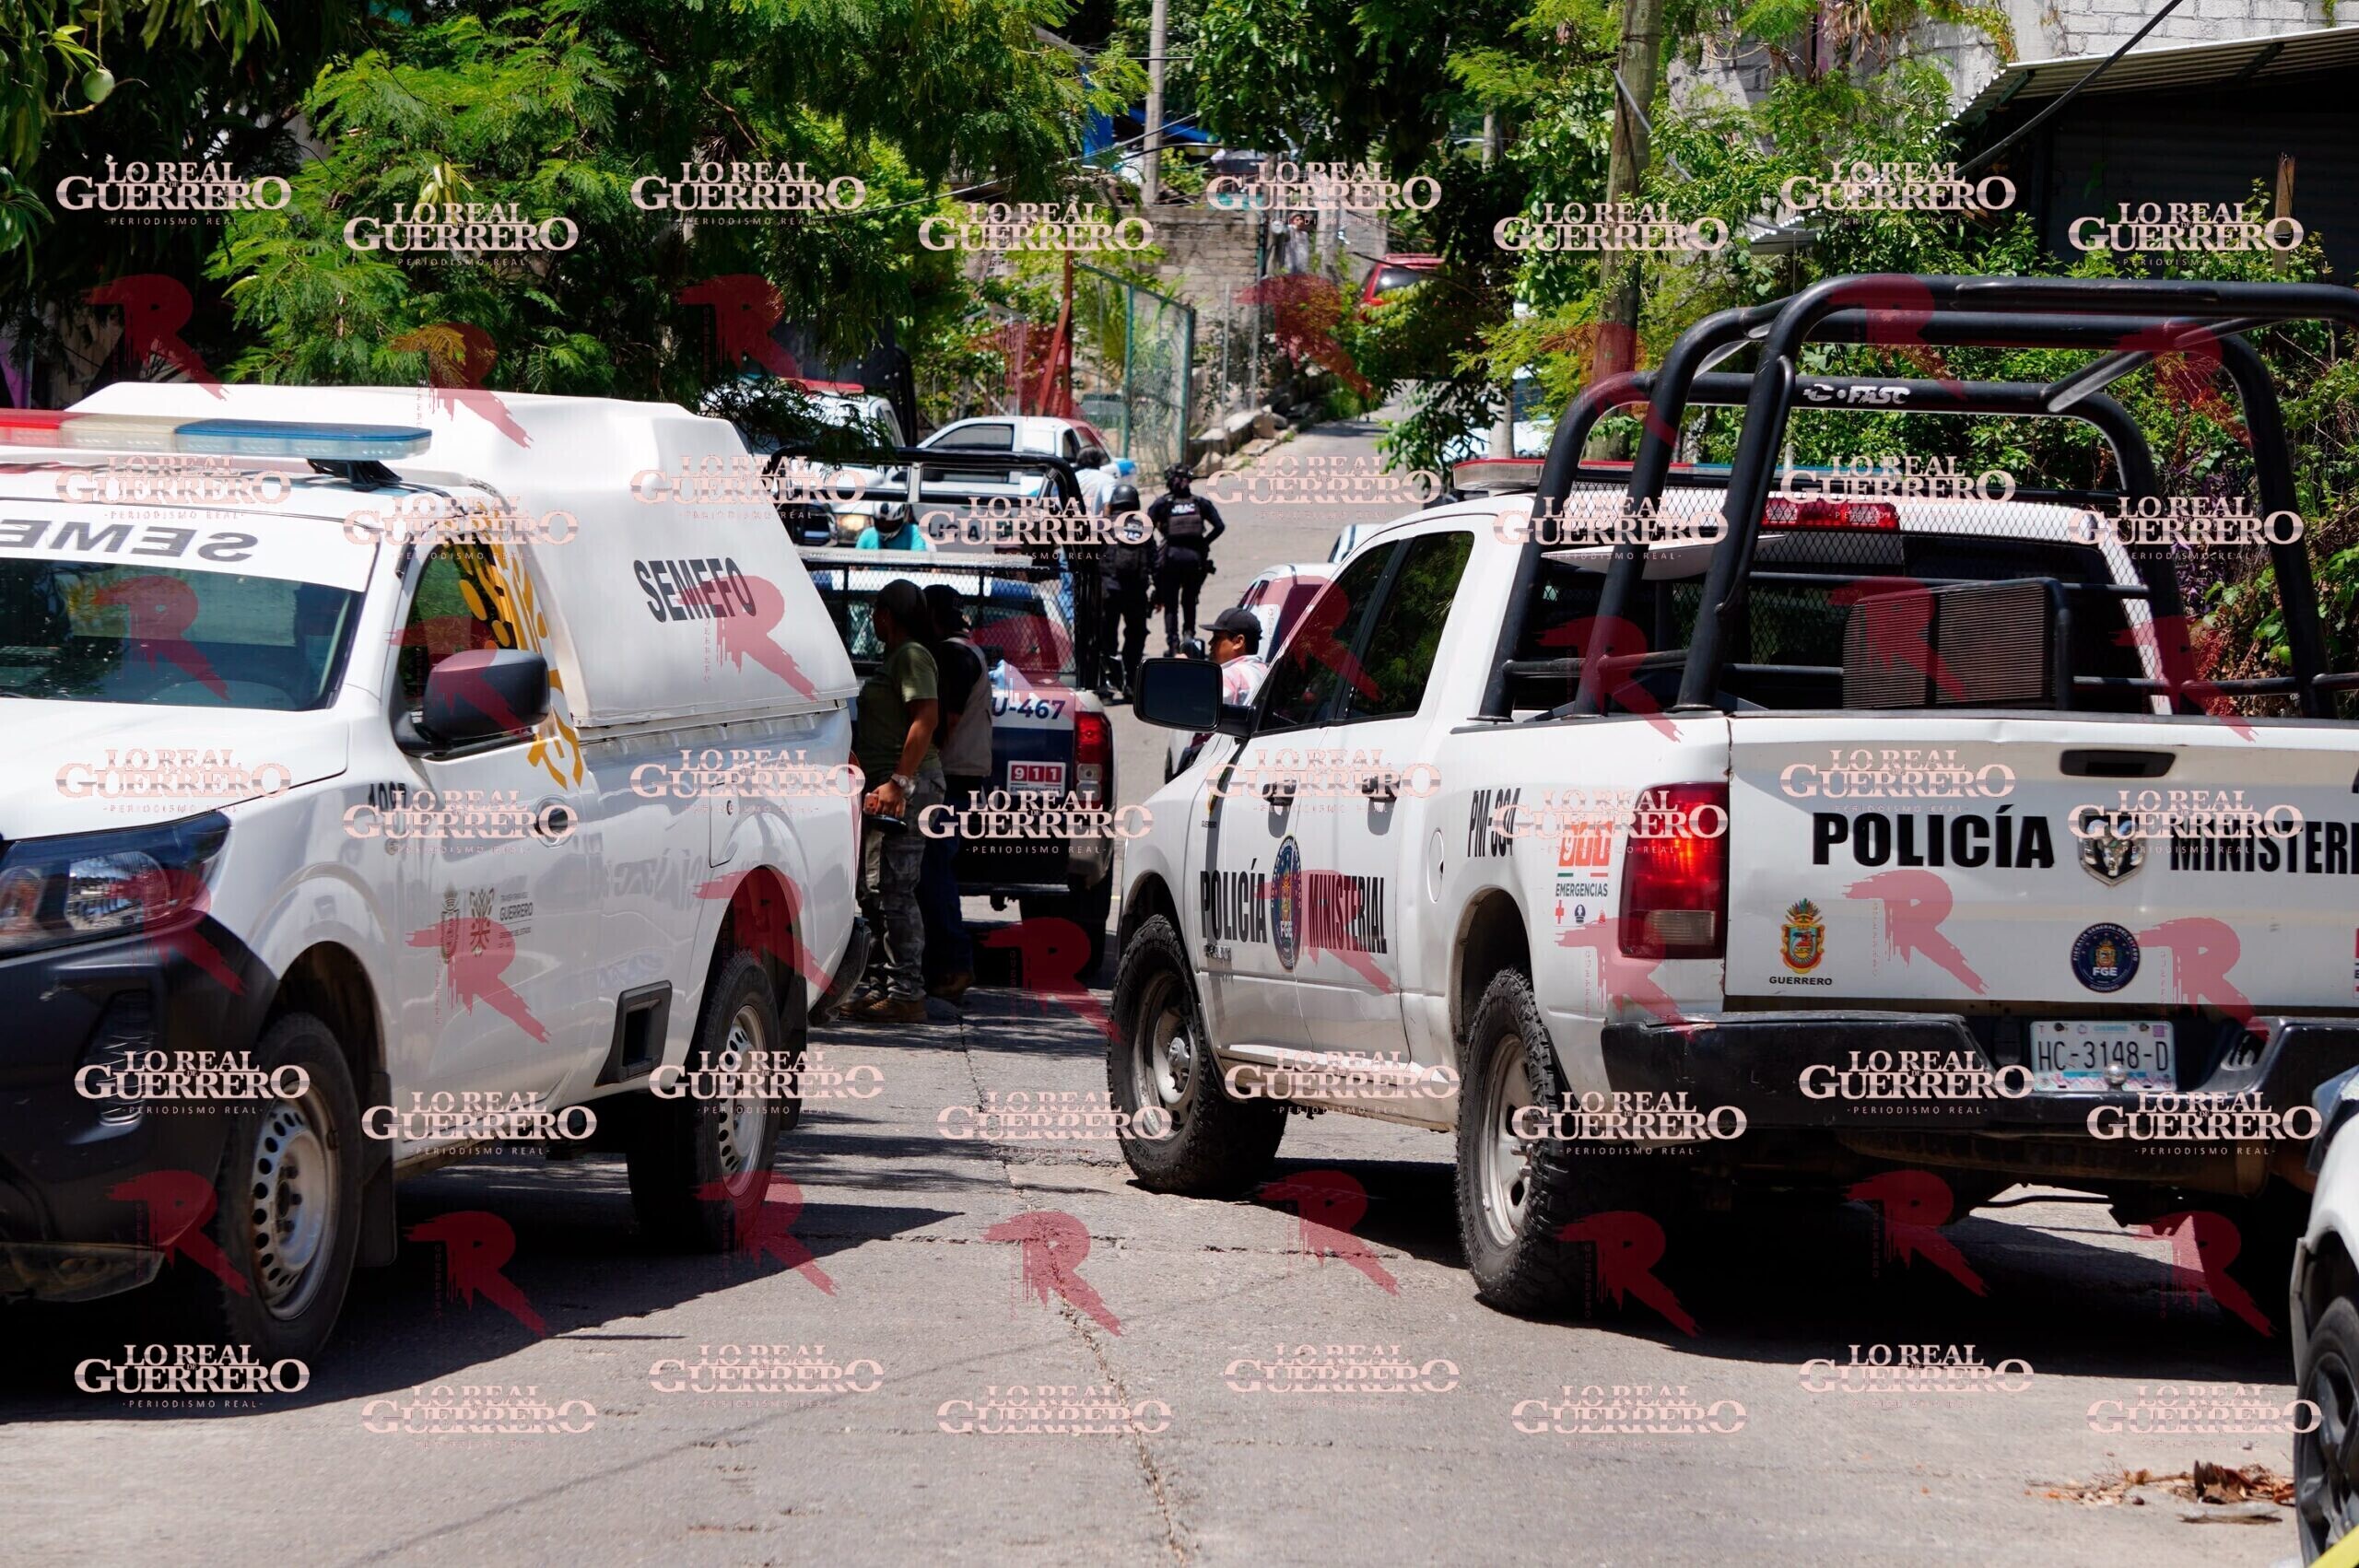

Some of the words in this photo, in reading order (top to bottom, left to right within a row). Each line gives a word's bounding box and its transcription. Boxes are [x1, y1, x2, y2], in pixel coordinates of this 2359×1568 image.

[633, 557, 757, 623] SEMEFO
[1012, 766, 1061, 781] 911
[1812, 804, 2055, 869] POLICÍA
[1200, 858, 1268, 943] POLICÍA
[1555, 883, 1608, 897] EMERGENCIAS
[1309, 873, 1388, 954] MINISTERIAL
[1768, 976, 1833, 986] GUERRERO
[2092, 966, 2118, 977] FGE
[2037, 1041, 2169, 1071] HC-3148-D
